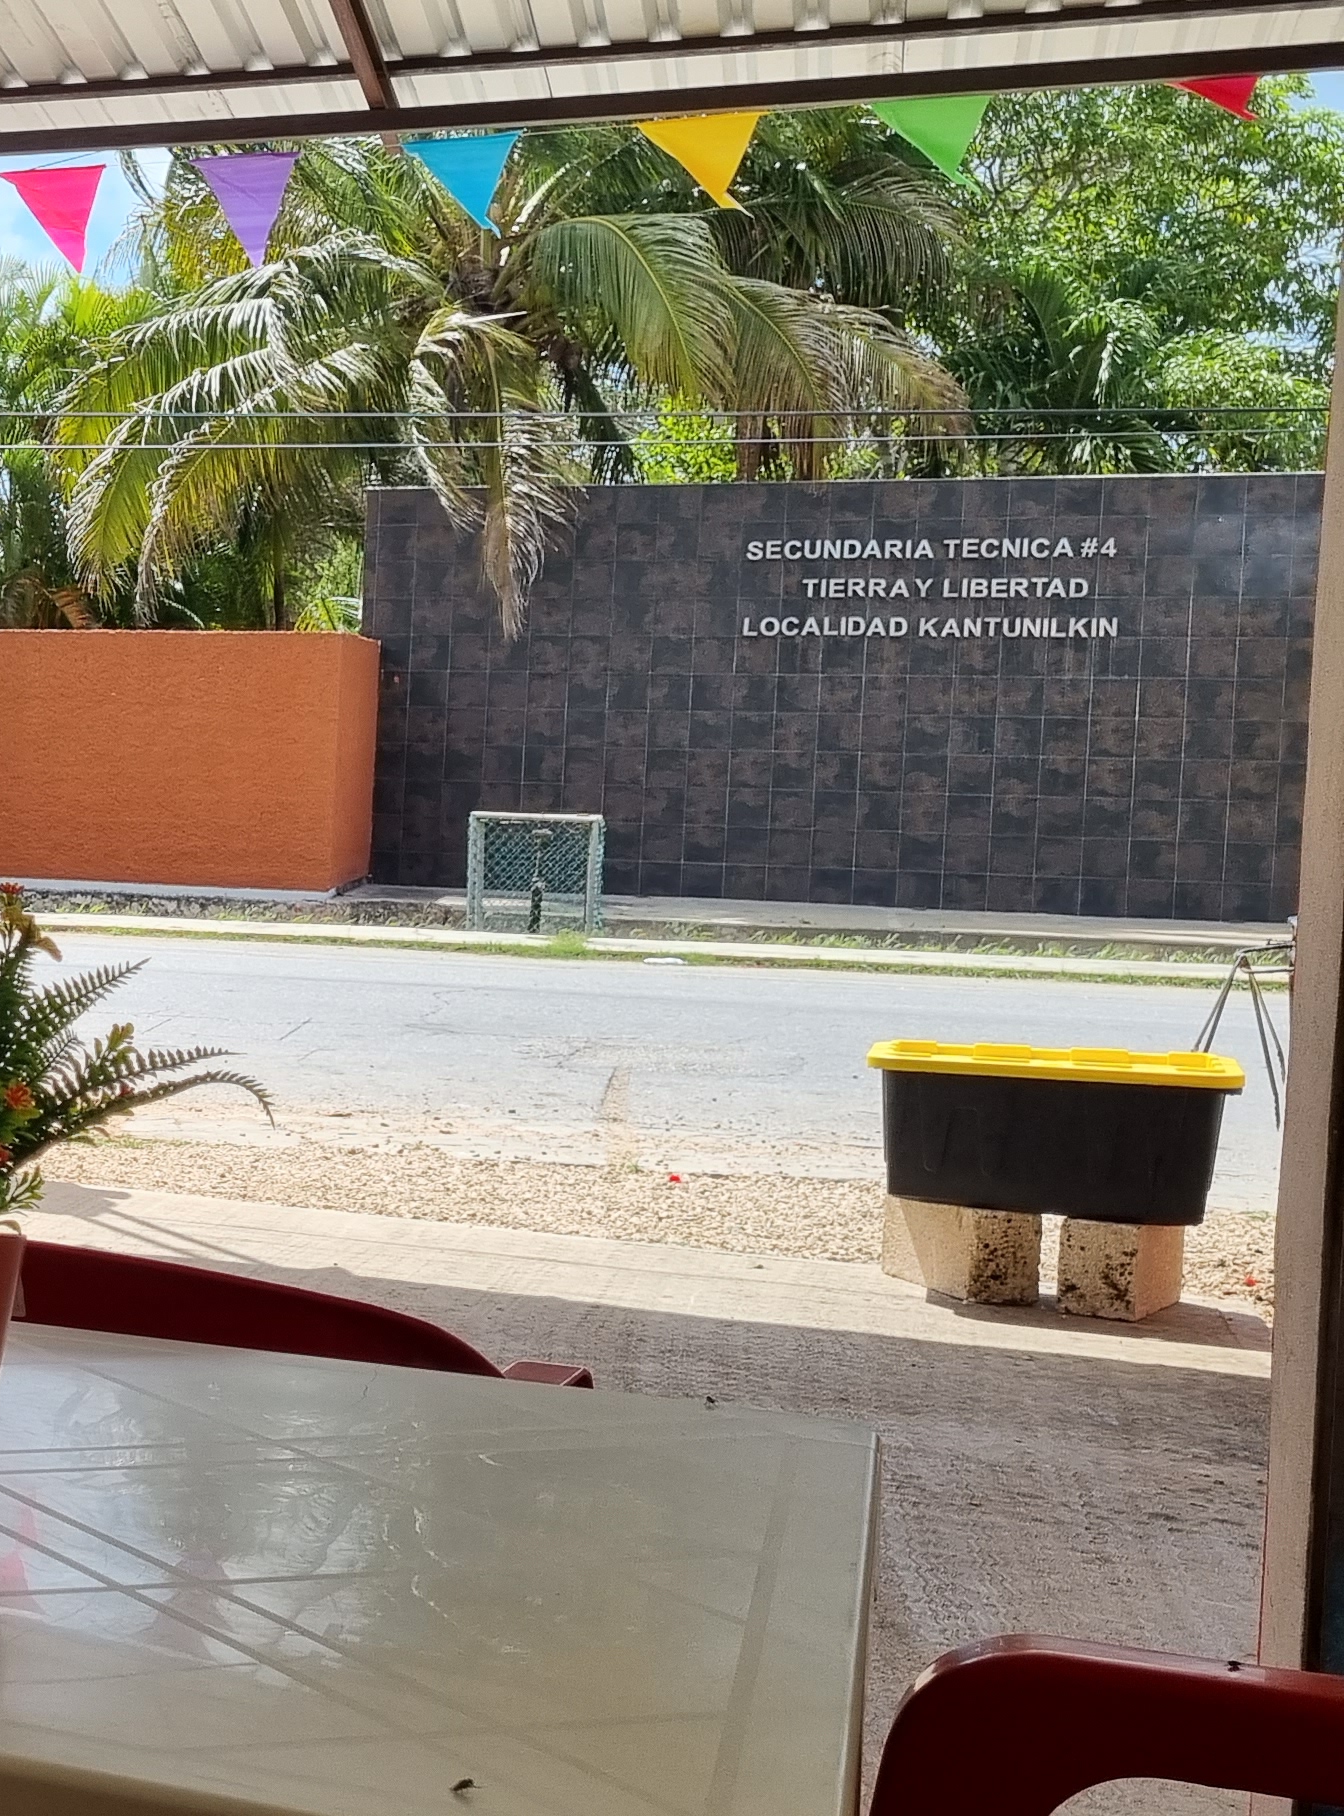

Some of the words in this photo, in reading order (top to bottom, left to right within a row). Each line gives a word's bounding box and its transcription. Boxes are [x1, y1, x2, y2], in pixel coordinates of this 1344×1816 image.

[745, 538, 934, 561] SECUNDARIA
[943, 536, 1074, 559] TECNICA
[1080, 536, 1118, 559] #4
[801, 577, 911, 599] TIERRA
[942, 576, 1090, 599] LIBERTAD
[741, 615, 909, 638] LOCALIDAD
[918, 616, 1119, 638] KANTUNILKIN
